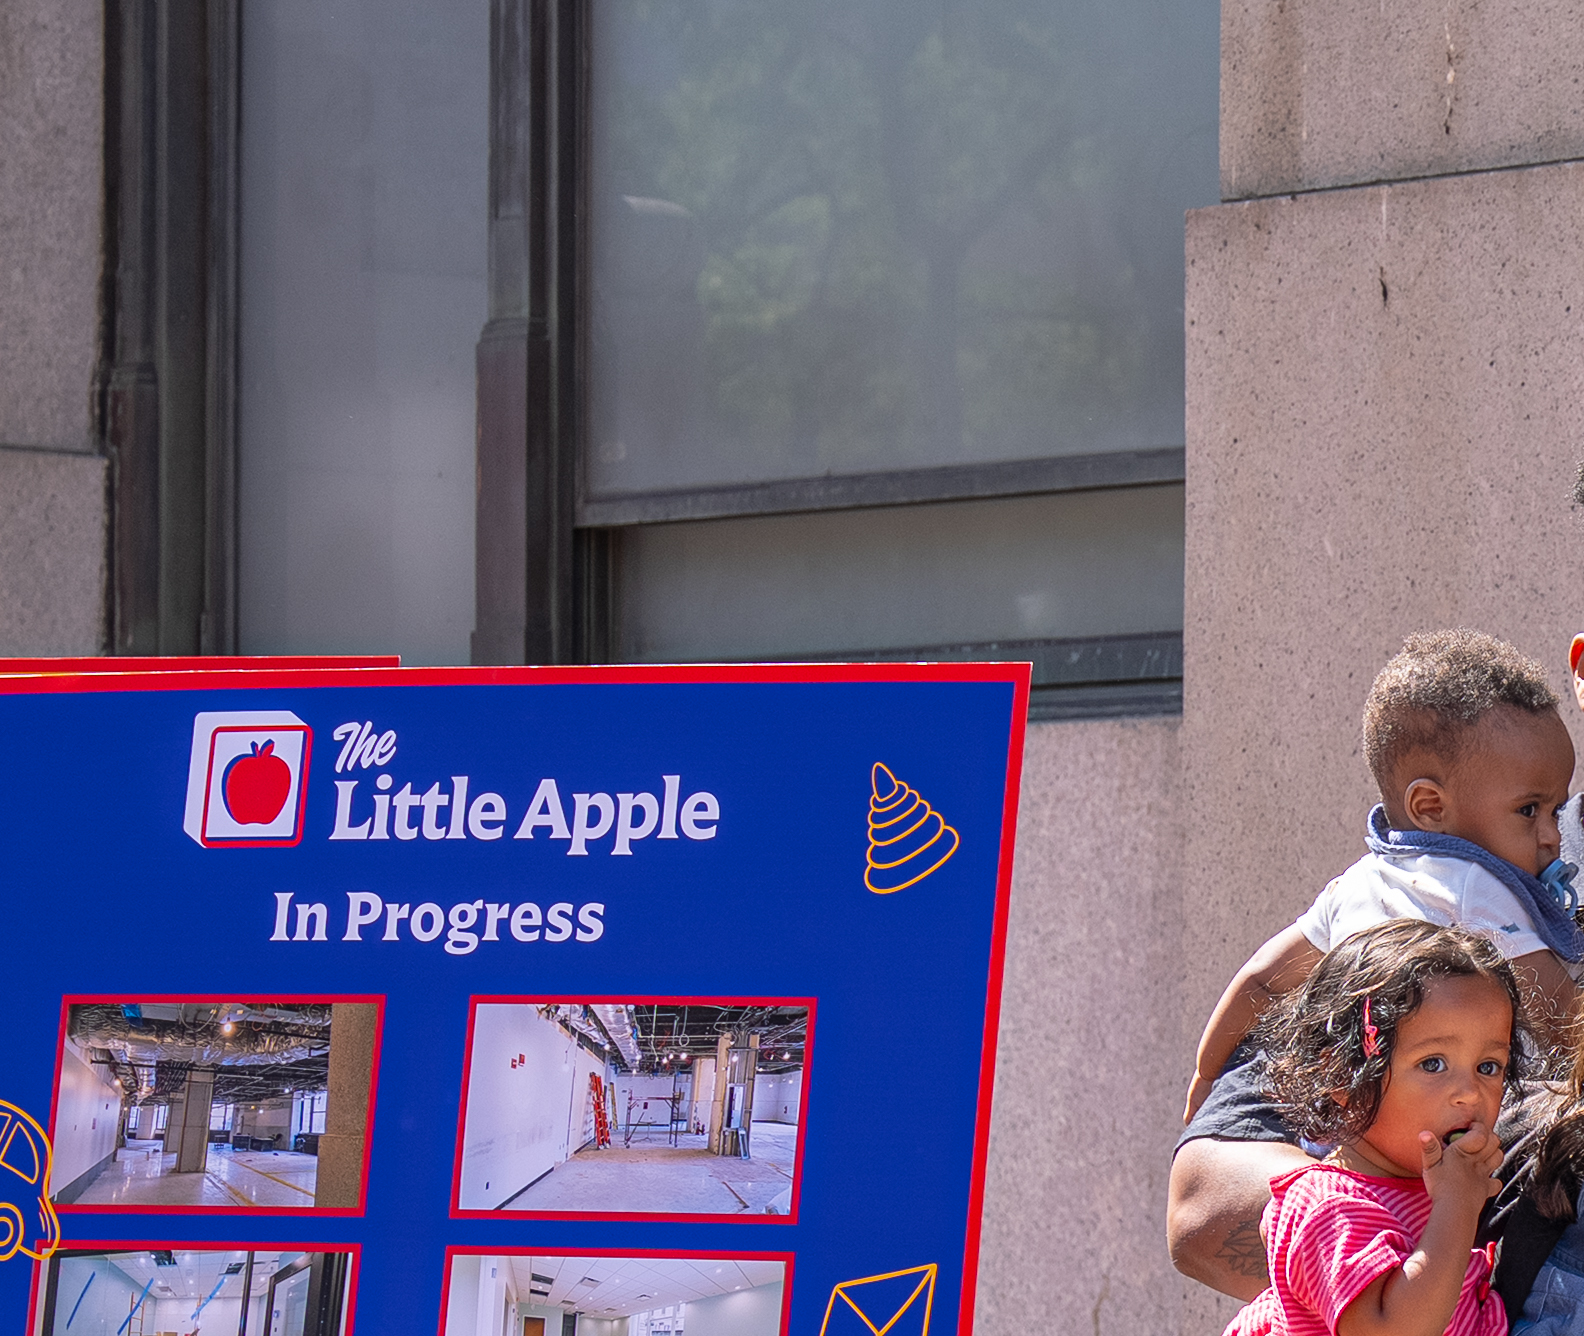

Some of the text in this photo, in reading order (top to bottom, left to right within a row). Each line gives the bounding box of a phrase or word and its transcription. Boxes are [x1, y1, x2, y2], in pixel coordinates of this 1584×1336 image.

[333, 721, 397, 773] The
[329, 774, 720, 856] Little Apple
[270, 890, 605, 955] In Progress
